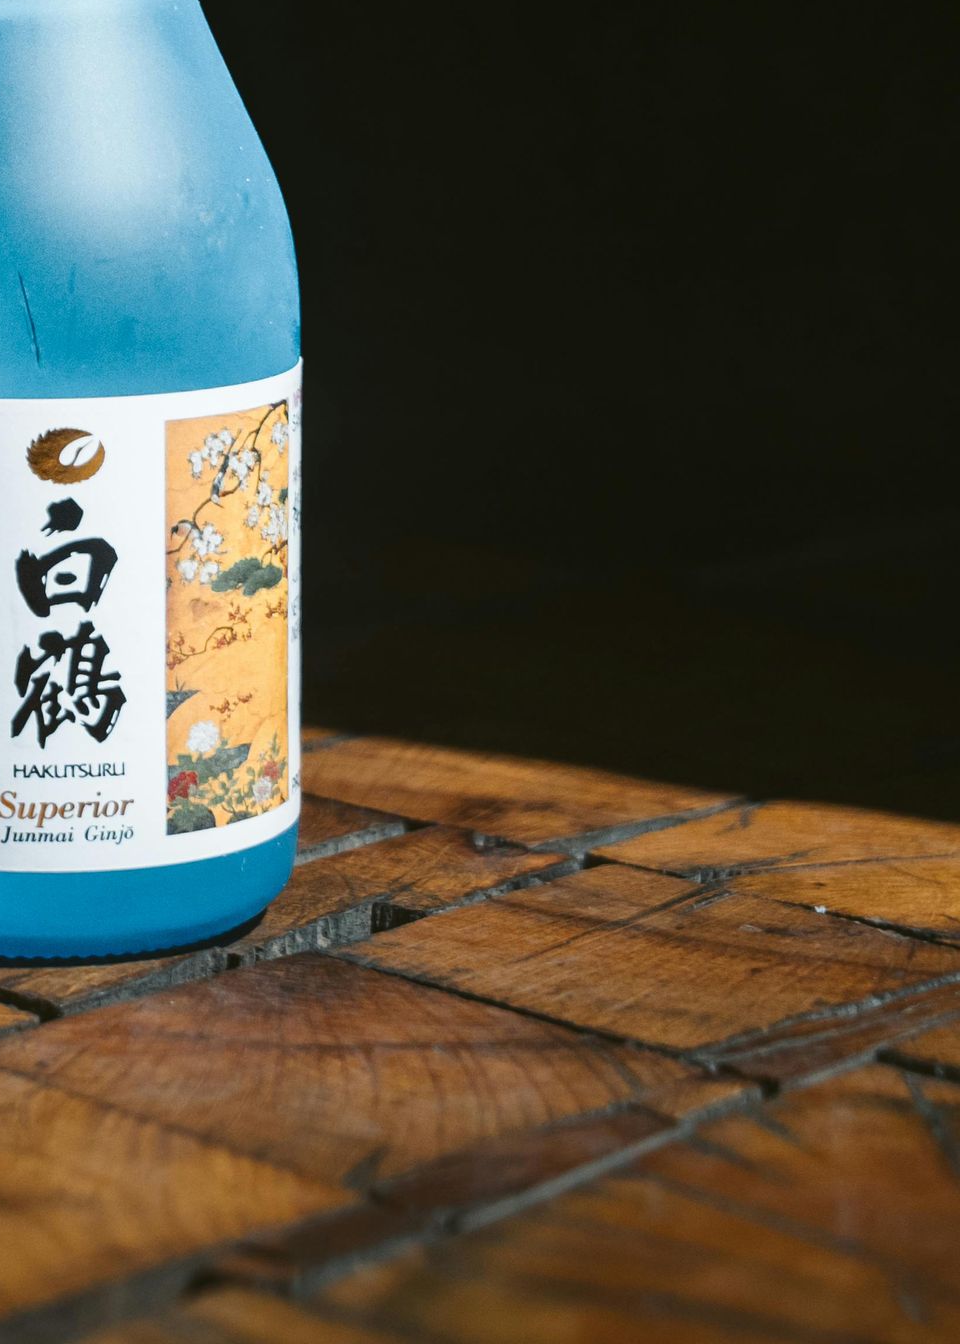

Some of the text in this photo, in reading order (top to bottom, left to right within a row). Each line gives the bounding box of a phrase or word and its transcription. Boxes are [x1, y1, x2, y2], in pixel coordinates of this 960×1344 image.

[11, 497, 127, 749] 白鶴
[13, 762, 126, 779] HAKUTSURU
[0, 825, 74, 844] Junmai
